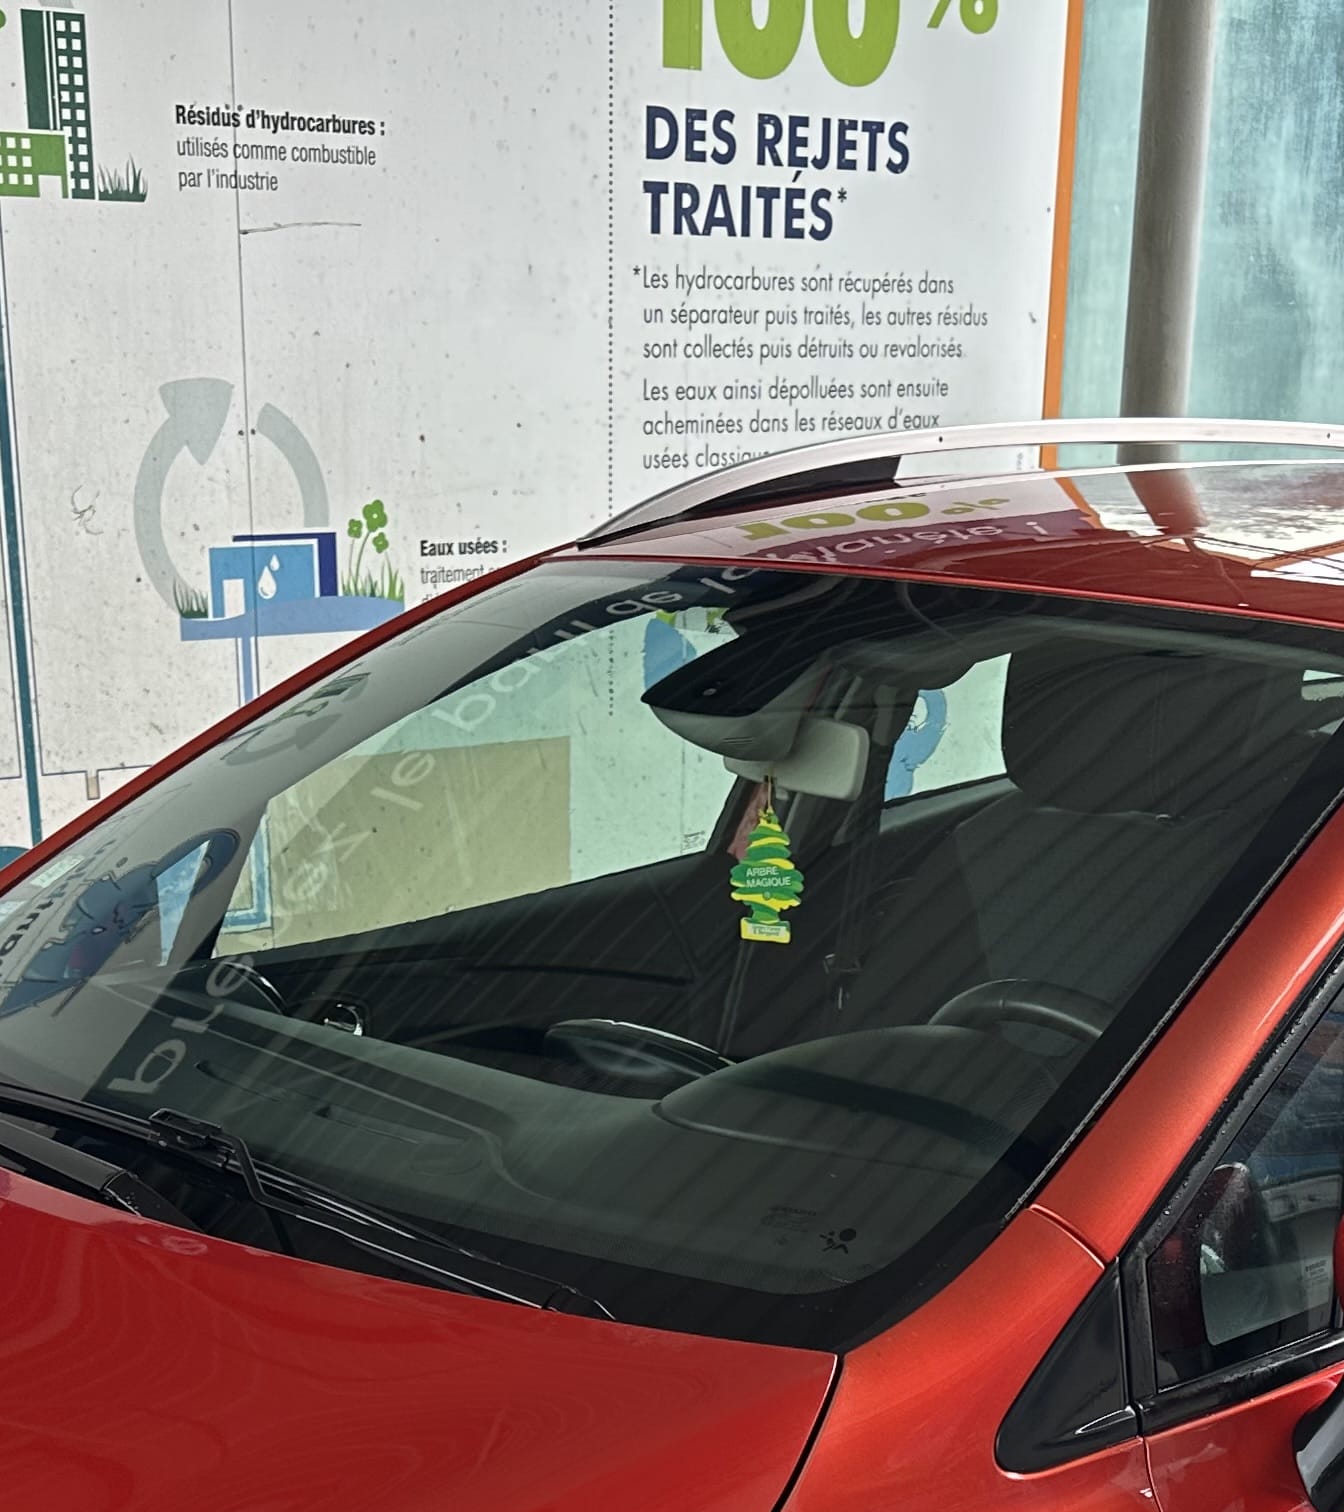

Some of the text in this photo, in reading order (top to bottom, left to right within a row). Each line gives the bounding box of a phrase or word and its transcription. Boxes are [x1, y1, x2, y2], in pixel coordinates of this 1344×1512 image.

[175, 104, 241, 128] Résidus
[246, 109, 376, 135] d'hydrocarbures
[176, 136, 377, 166] utilisés comme combustible
[644, 104, 910, 174] DES REJETS
[178, 168, 279, 192] par l'industrie
[675, 264, 795, 297] hydrocarbures
[801, 272, 833, 293] sont
[838, 271, 913, 300] récupérés
[918, 270, 955, 295] dans
[643, 301, 988, 332] un séparateur puis traités, les autres résidus
[643, 339, 677, 359] sont
[683, 332, 754, 360] collectés
[759, 337, 792, 365] puis
[798, 334, 854, 359] détruits
[859, 343, 878, 359] ou
[643, 375, 949, 406] Les eaux ainsi dépolluées sont ensuite
[642, 408, 941, 436] acheminées dans les réseaux d'eaux
[642, 443, 769, 469] usées classi
[420, 540, 455, 557] Eaux
[458, 537, 499, 555] usées
[746, 866, 779, 877] ARBRE
[746, 876, 792, 888] MAGIQUE
